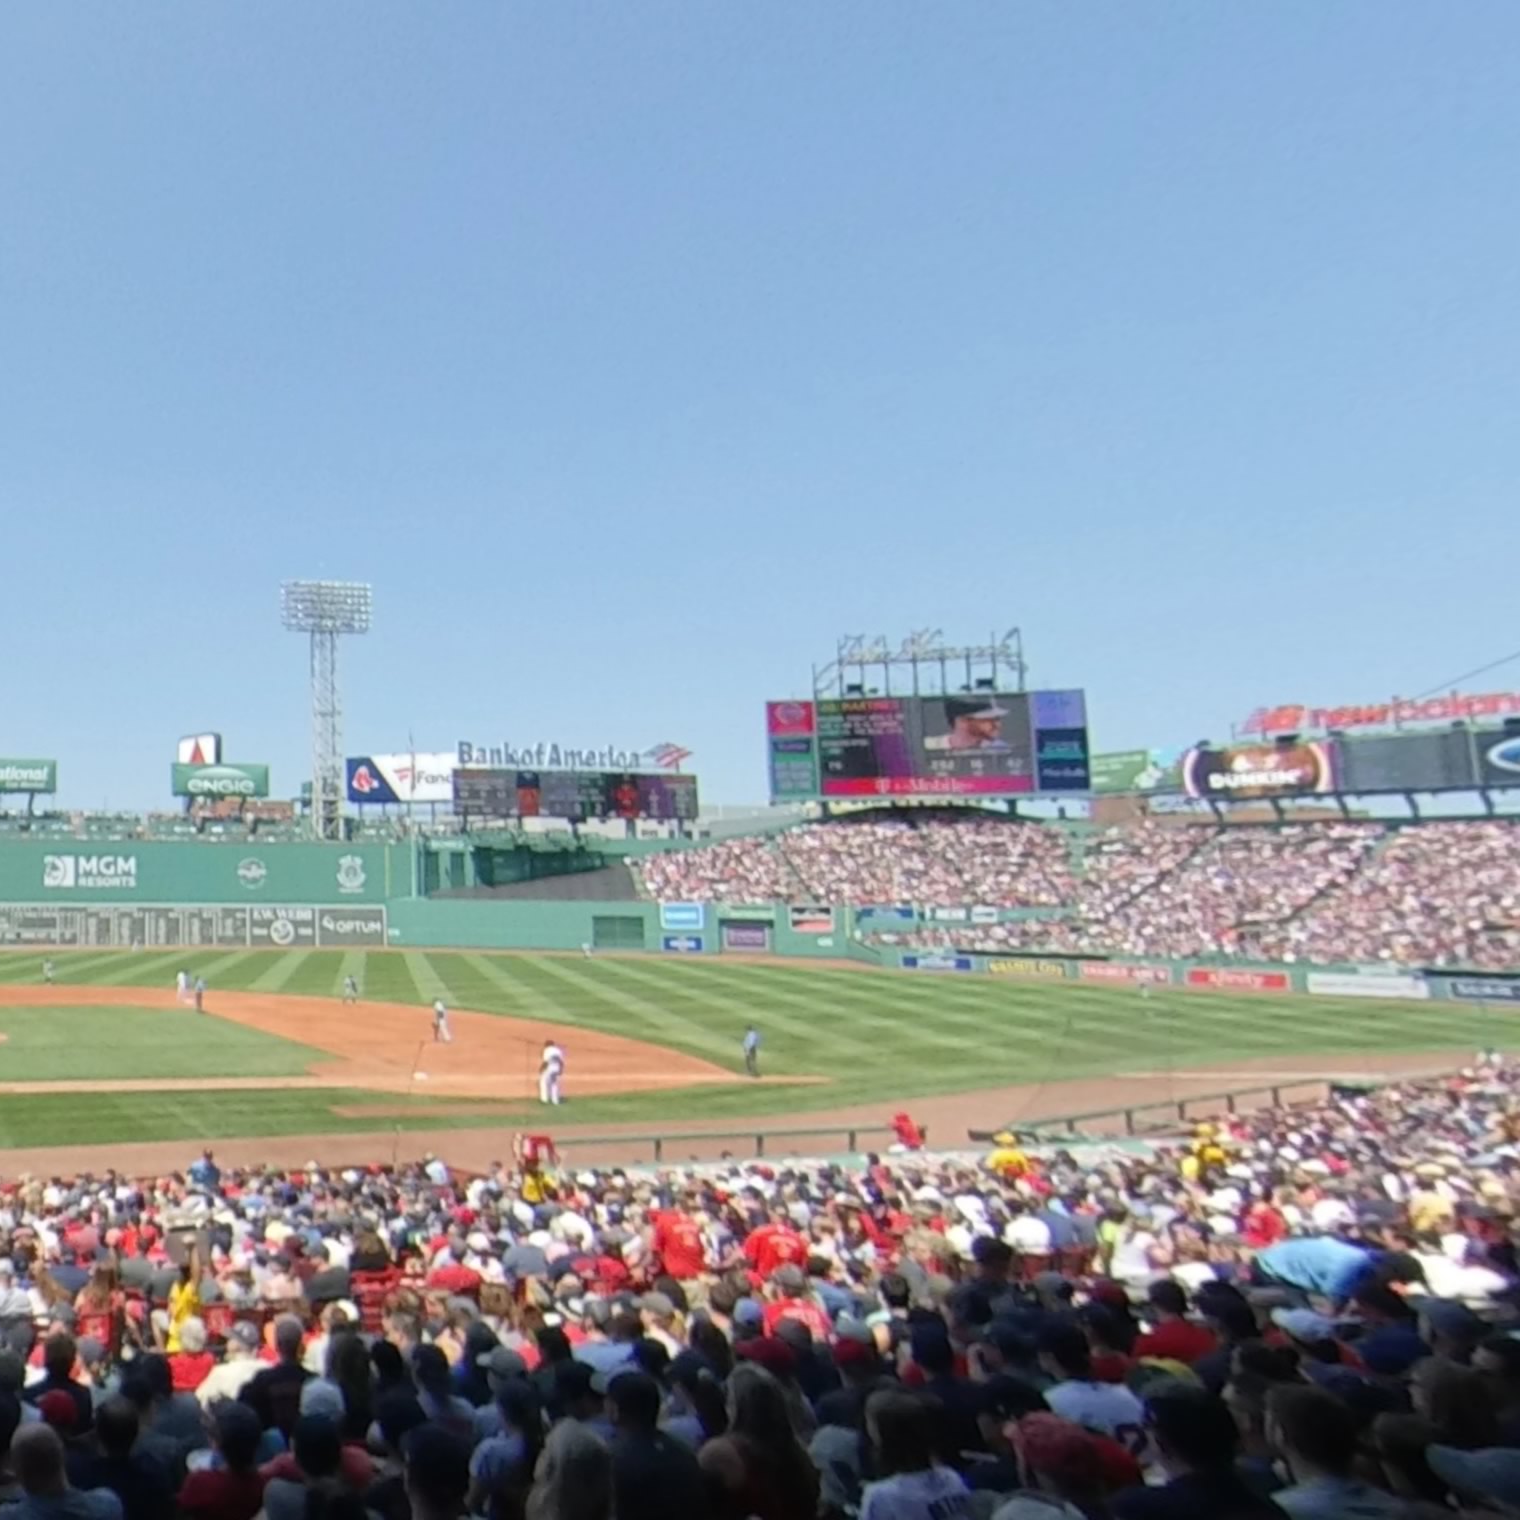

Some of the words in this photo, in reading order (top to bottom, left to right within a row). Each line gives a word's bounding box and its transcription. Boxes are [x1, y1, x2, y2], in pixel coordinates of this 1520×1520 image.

[458, 741, 518, 766] Bank
[519, 744, 547, 766] of
[547, 744, 641, 769] America
[78, 855, 136, 875] MGM
[78, 876, 136, 888] RESORTS
[335, 919, 382, 933] OPTUM
